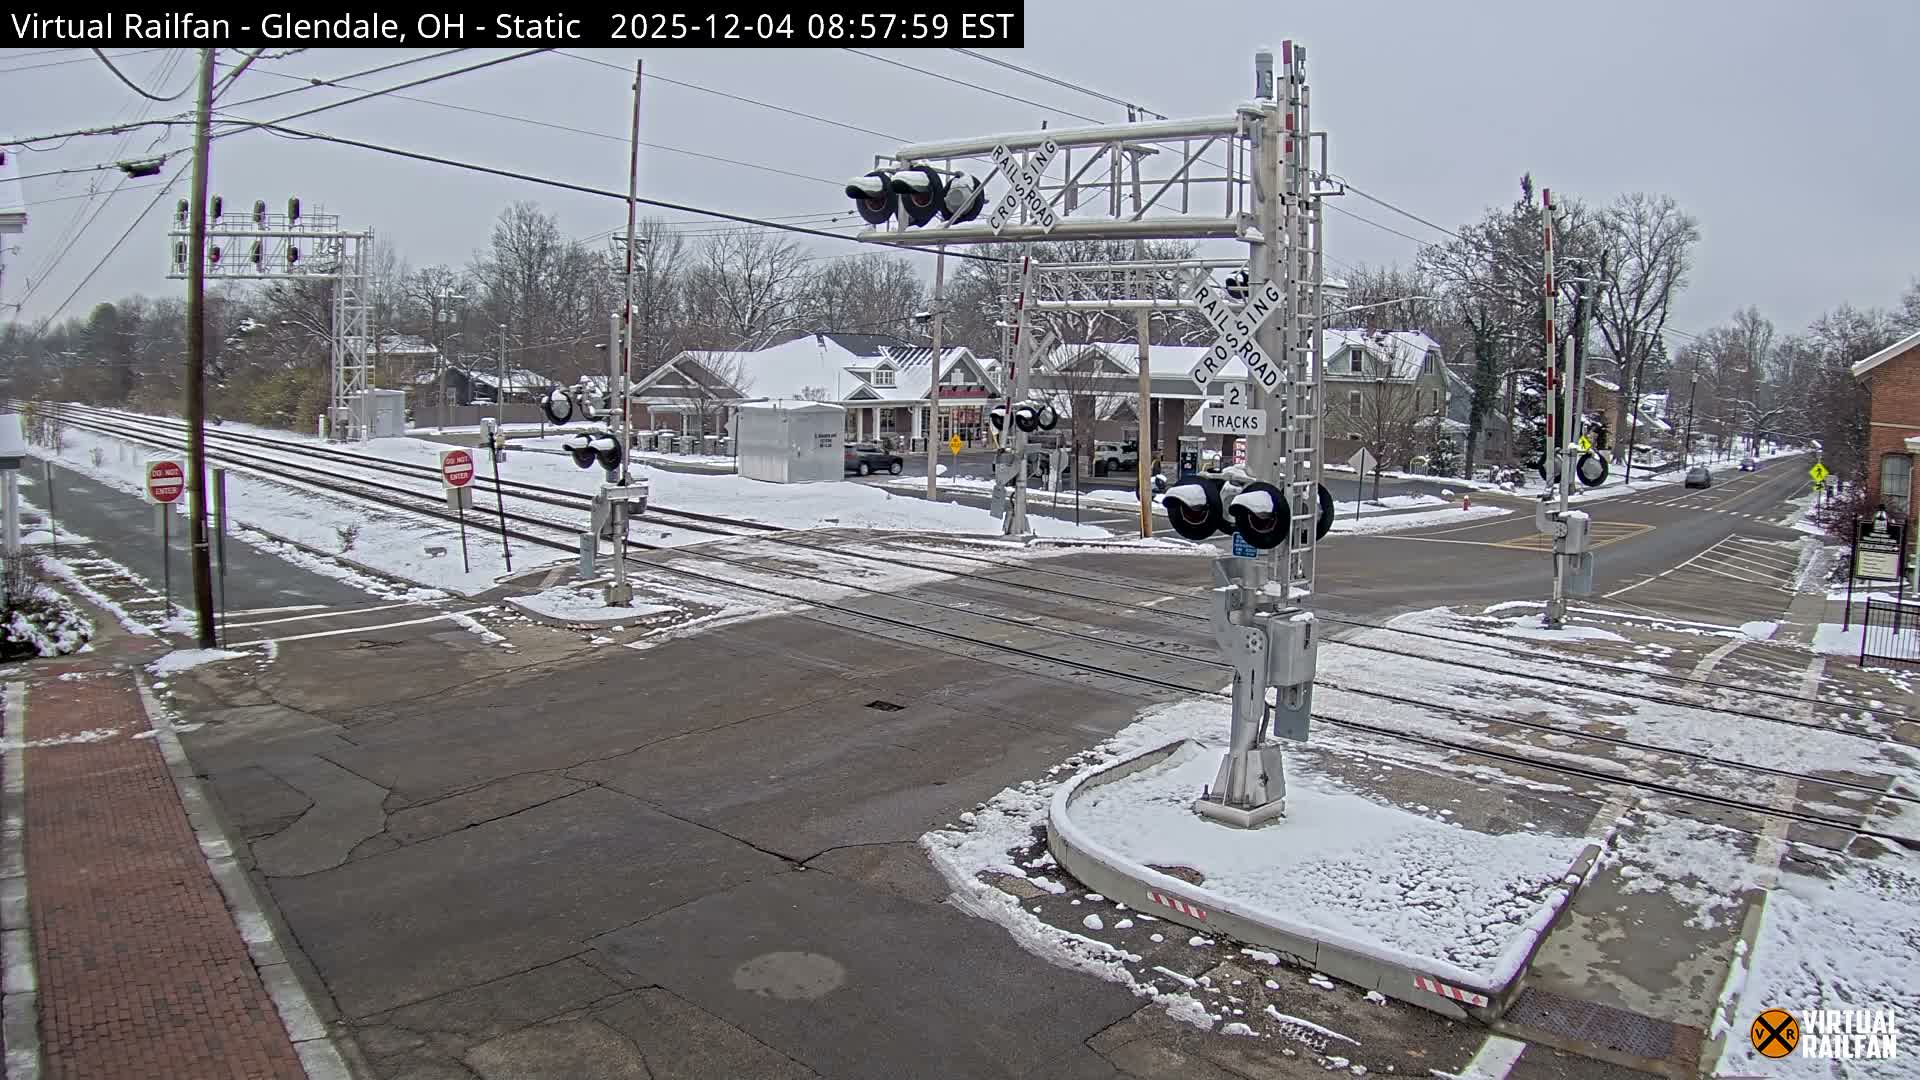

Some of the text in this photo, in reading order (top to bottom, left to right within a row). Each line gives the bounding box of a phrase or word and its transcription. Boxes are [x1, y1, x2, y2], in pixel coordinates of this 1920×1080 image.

[990, 140, 1055, 229] CROSSING
[993, 145, 1054, 227] RAILROAD
[1194, 286, 1279, 384] CROSSING
[1195, 286, 1277, 387] RAILROAD
[1229, 387, 1240, 405] 2
[1210, 414, 1258, 430] TRACKS
[456, 456, 468, 464] NOT
[165, 468, 179, 476] NOT
[449, 472, 468, 481] ENTER
[155, 486, 177, 495] ENTER
